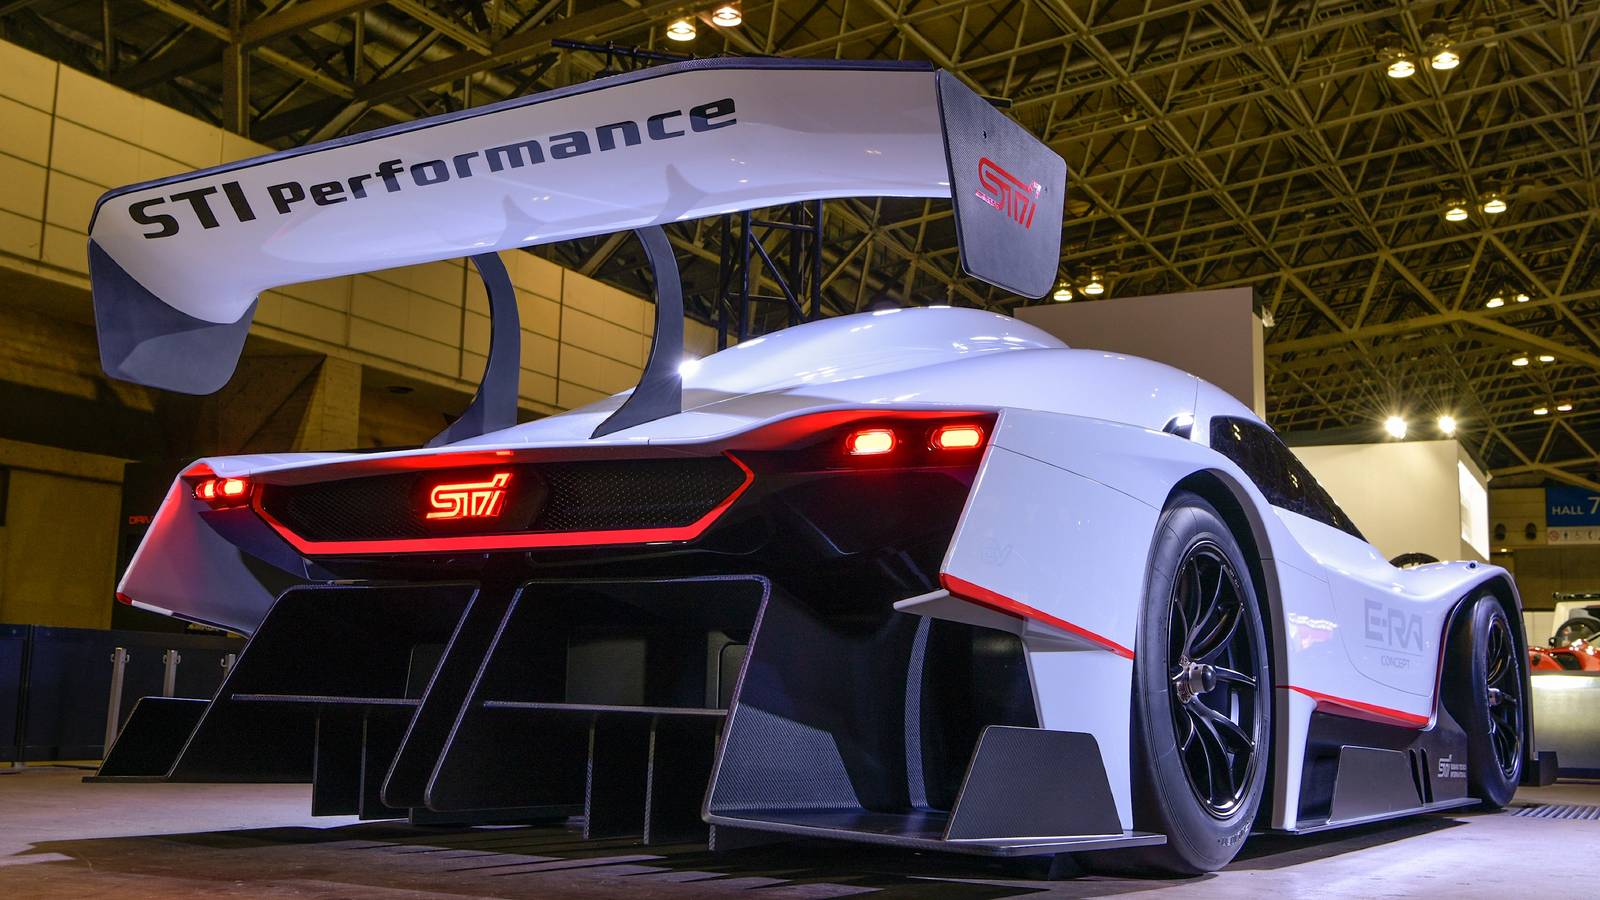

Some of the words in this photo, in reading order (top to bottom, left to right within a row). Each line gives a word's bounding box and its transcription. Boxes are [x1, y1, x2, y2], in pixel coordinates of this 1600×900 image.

[128, 181, 256, 240] STI
[266, 97, 737, 215] Performance
[1551, 505, 1584, 515] HALL
[1587, 496, 1600, 514] 7
[1381, 655, 1410, 669] CONCEPT
